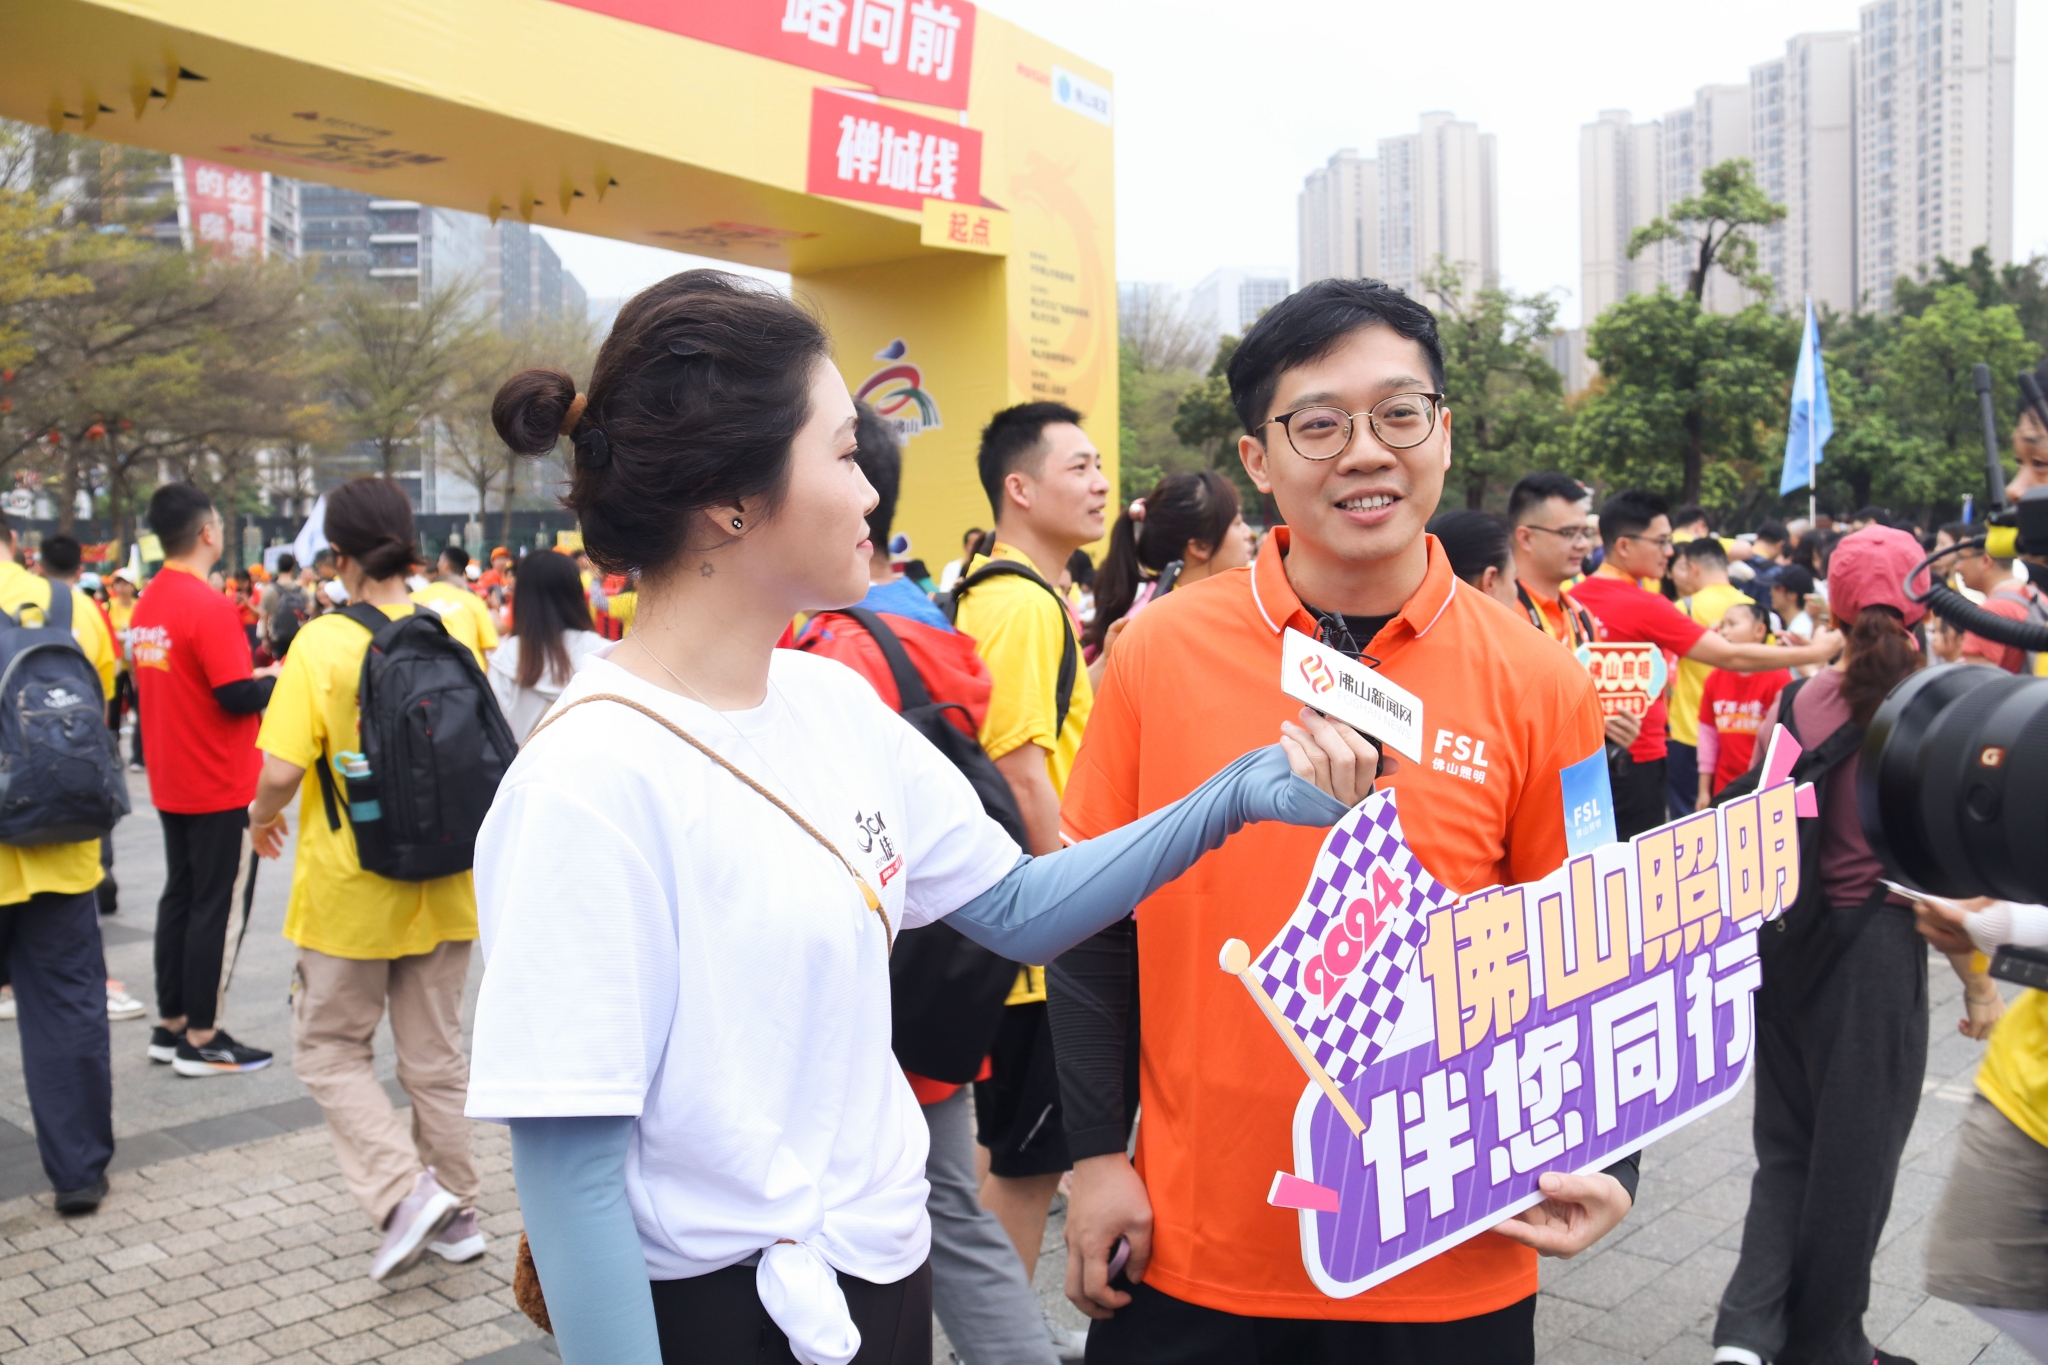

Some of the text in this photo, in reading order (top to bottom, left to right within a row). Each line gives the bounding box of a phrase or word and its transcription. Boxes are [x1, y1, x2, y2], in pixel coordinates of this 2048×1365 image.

[836, 114, 959, 200] 禅城线
[947, 210, 991, 247] 起点
[1337, 691, 1412, 740] FOSHAN NEWS
[1338, 670, 1412, 727] 佛山新闻网
[1432, 757, 1486, 785] 佛山照明
[1433, 729, 1489, 767] FSL
[1982, 747, 2000, 766] G
[1573, 798, 1602, 828] FSL
[1303, 864, 1405, 1010] 2024
[1420, 779, 1800, 1062] 佛山照明
[1361, 929, 1763, 1244] 伴您同行
